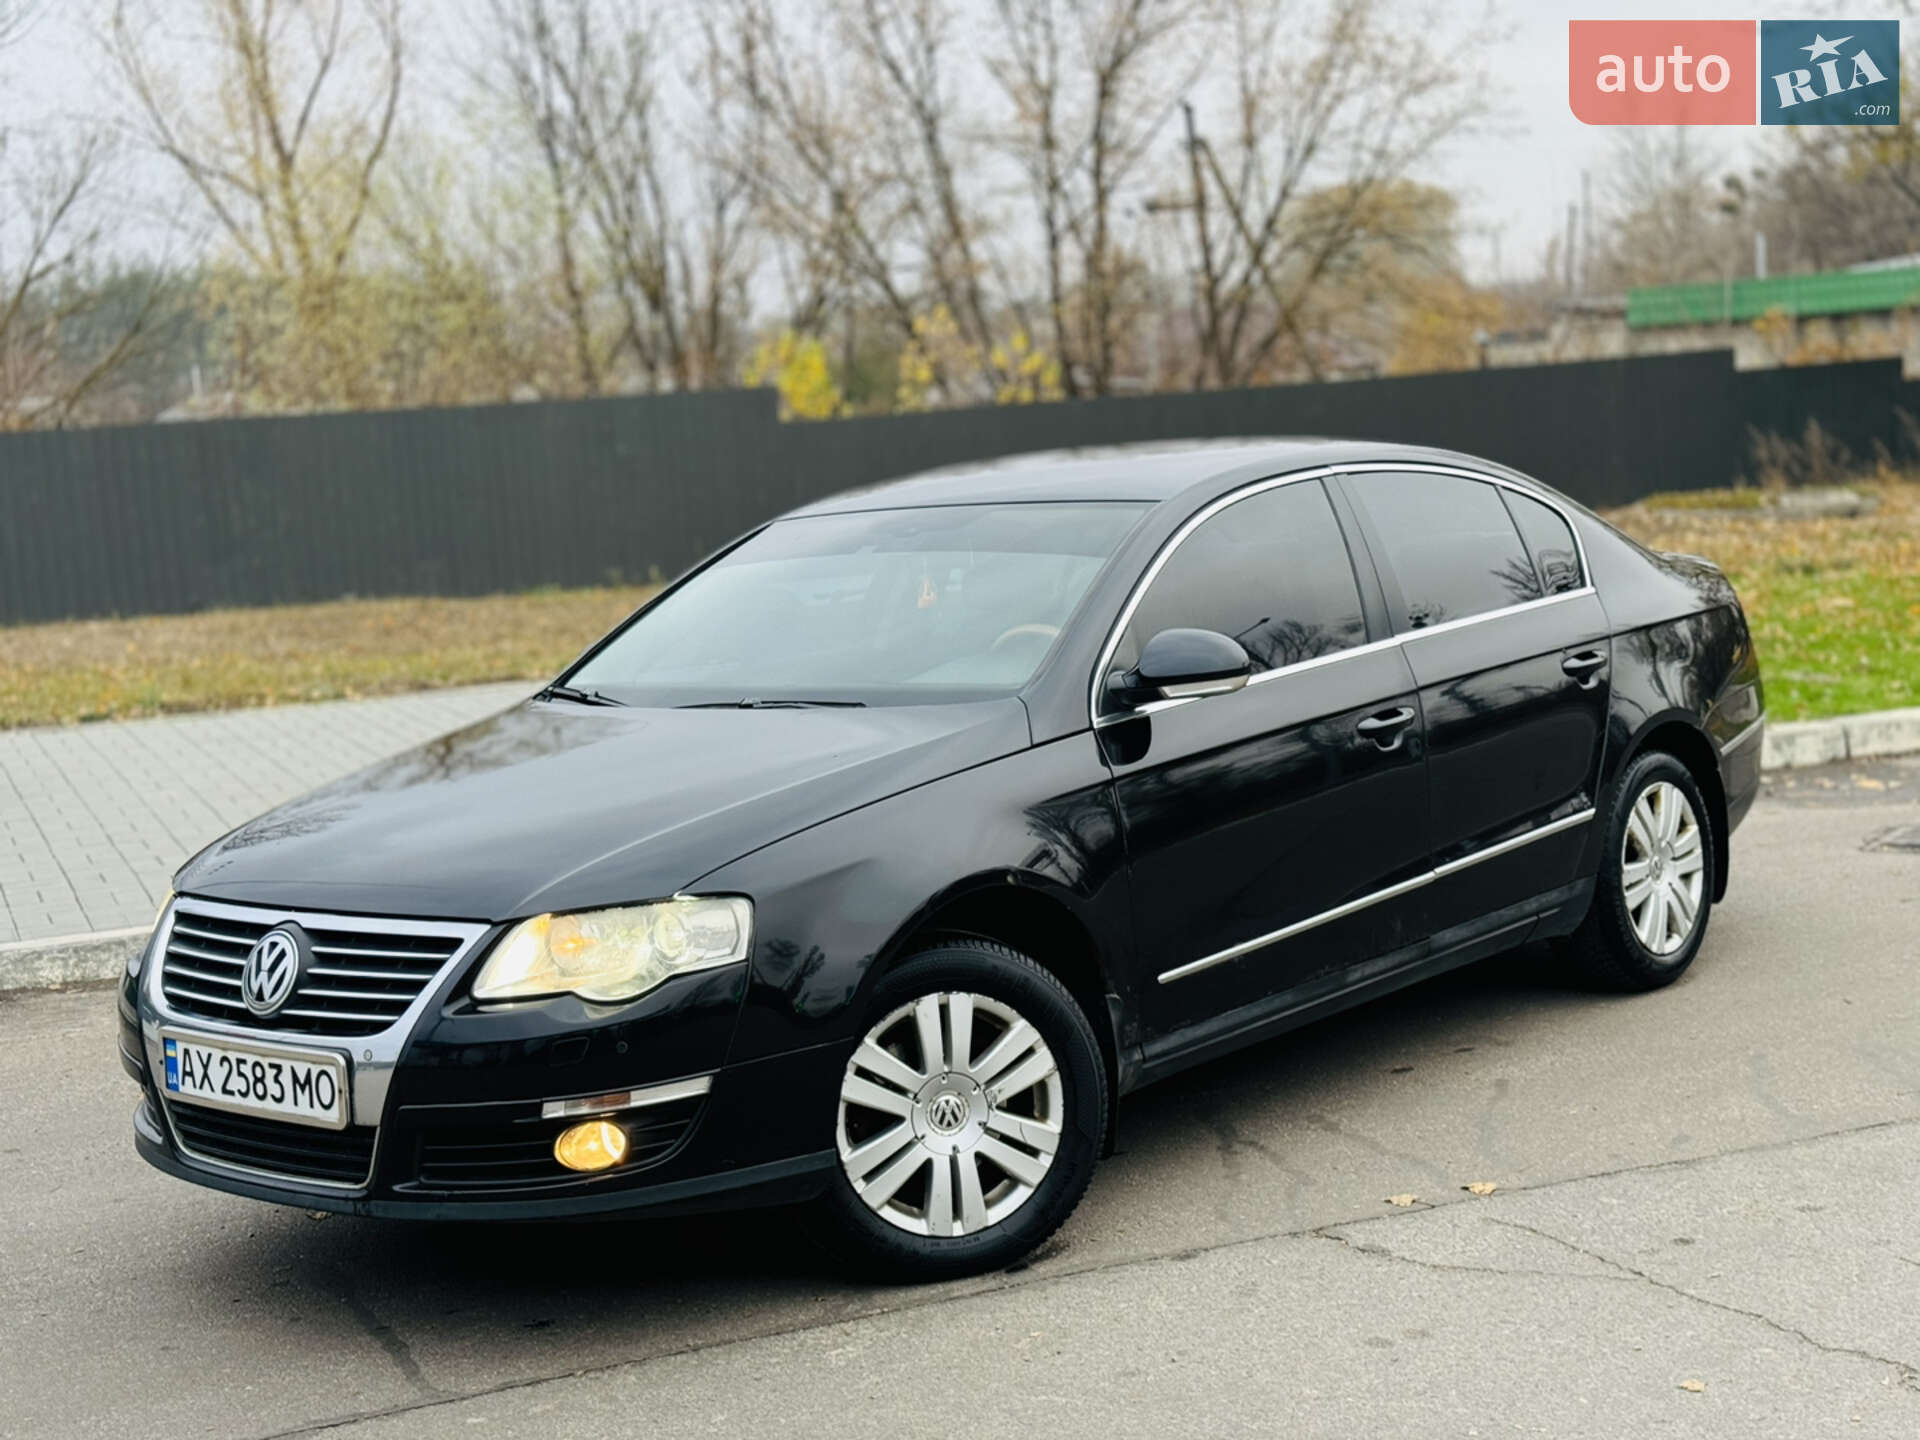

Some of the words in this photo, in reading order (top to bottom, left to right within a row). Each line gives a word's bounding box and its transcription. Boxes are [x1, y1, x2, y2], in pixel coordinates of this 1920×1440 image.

[167, 1073, 179, 1085] UA
[181, 1048, 215, 1093] AX
[219, 1055, 286, 1103] 2583
[290, 1065, 336, 1111] MO
